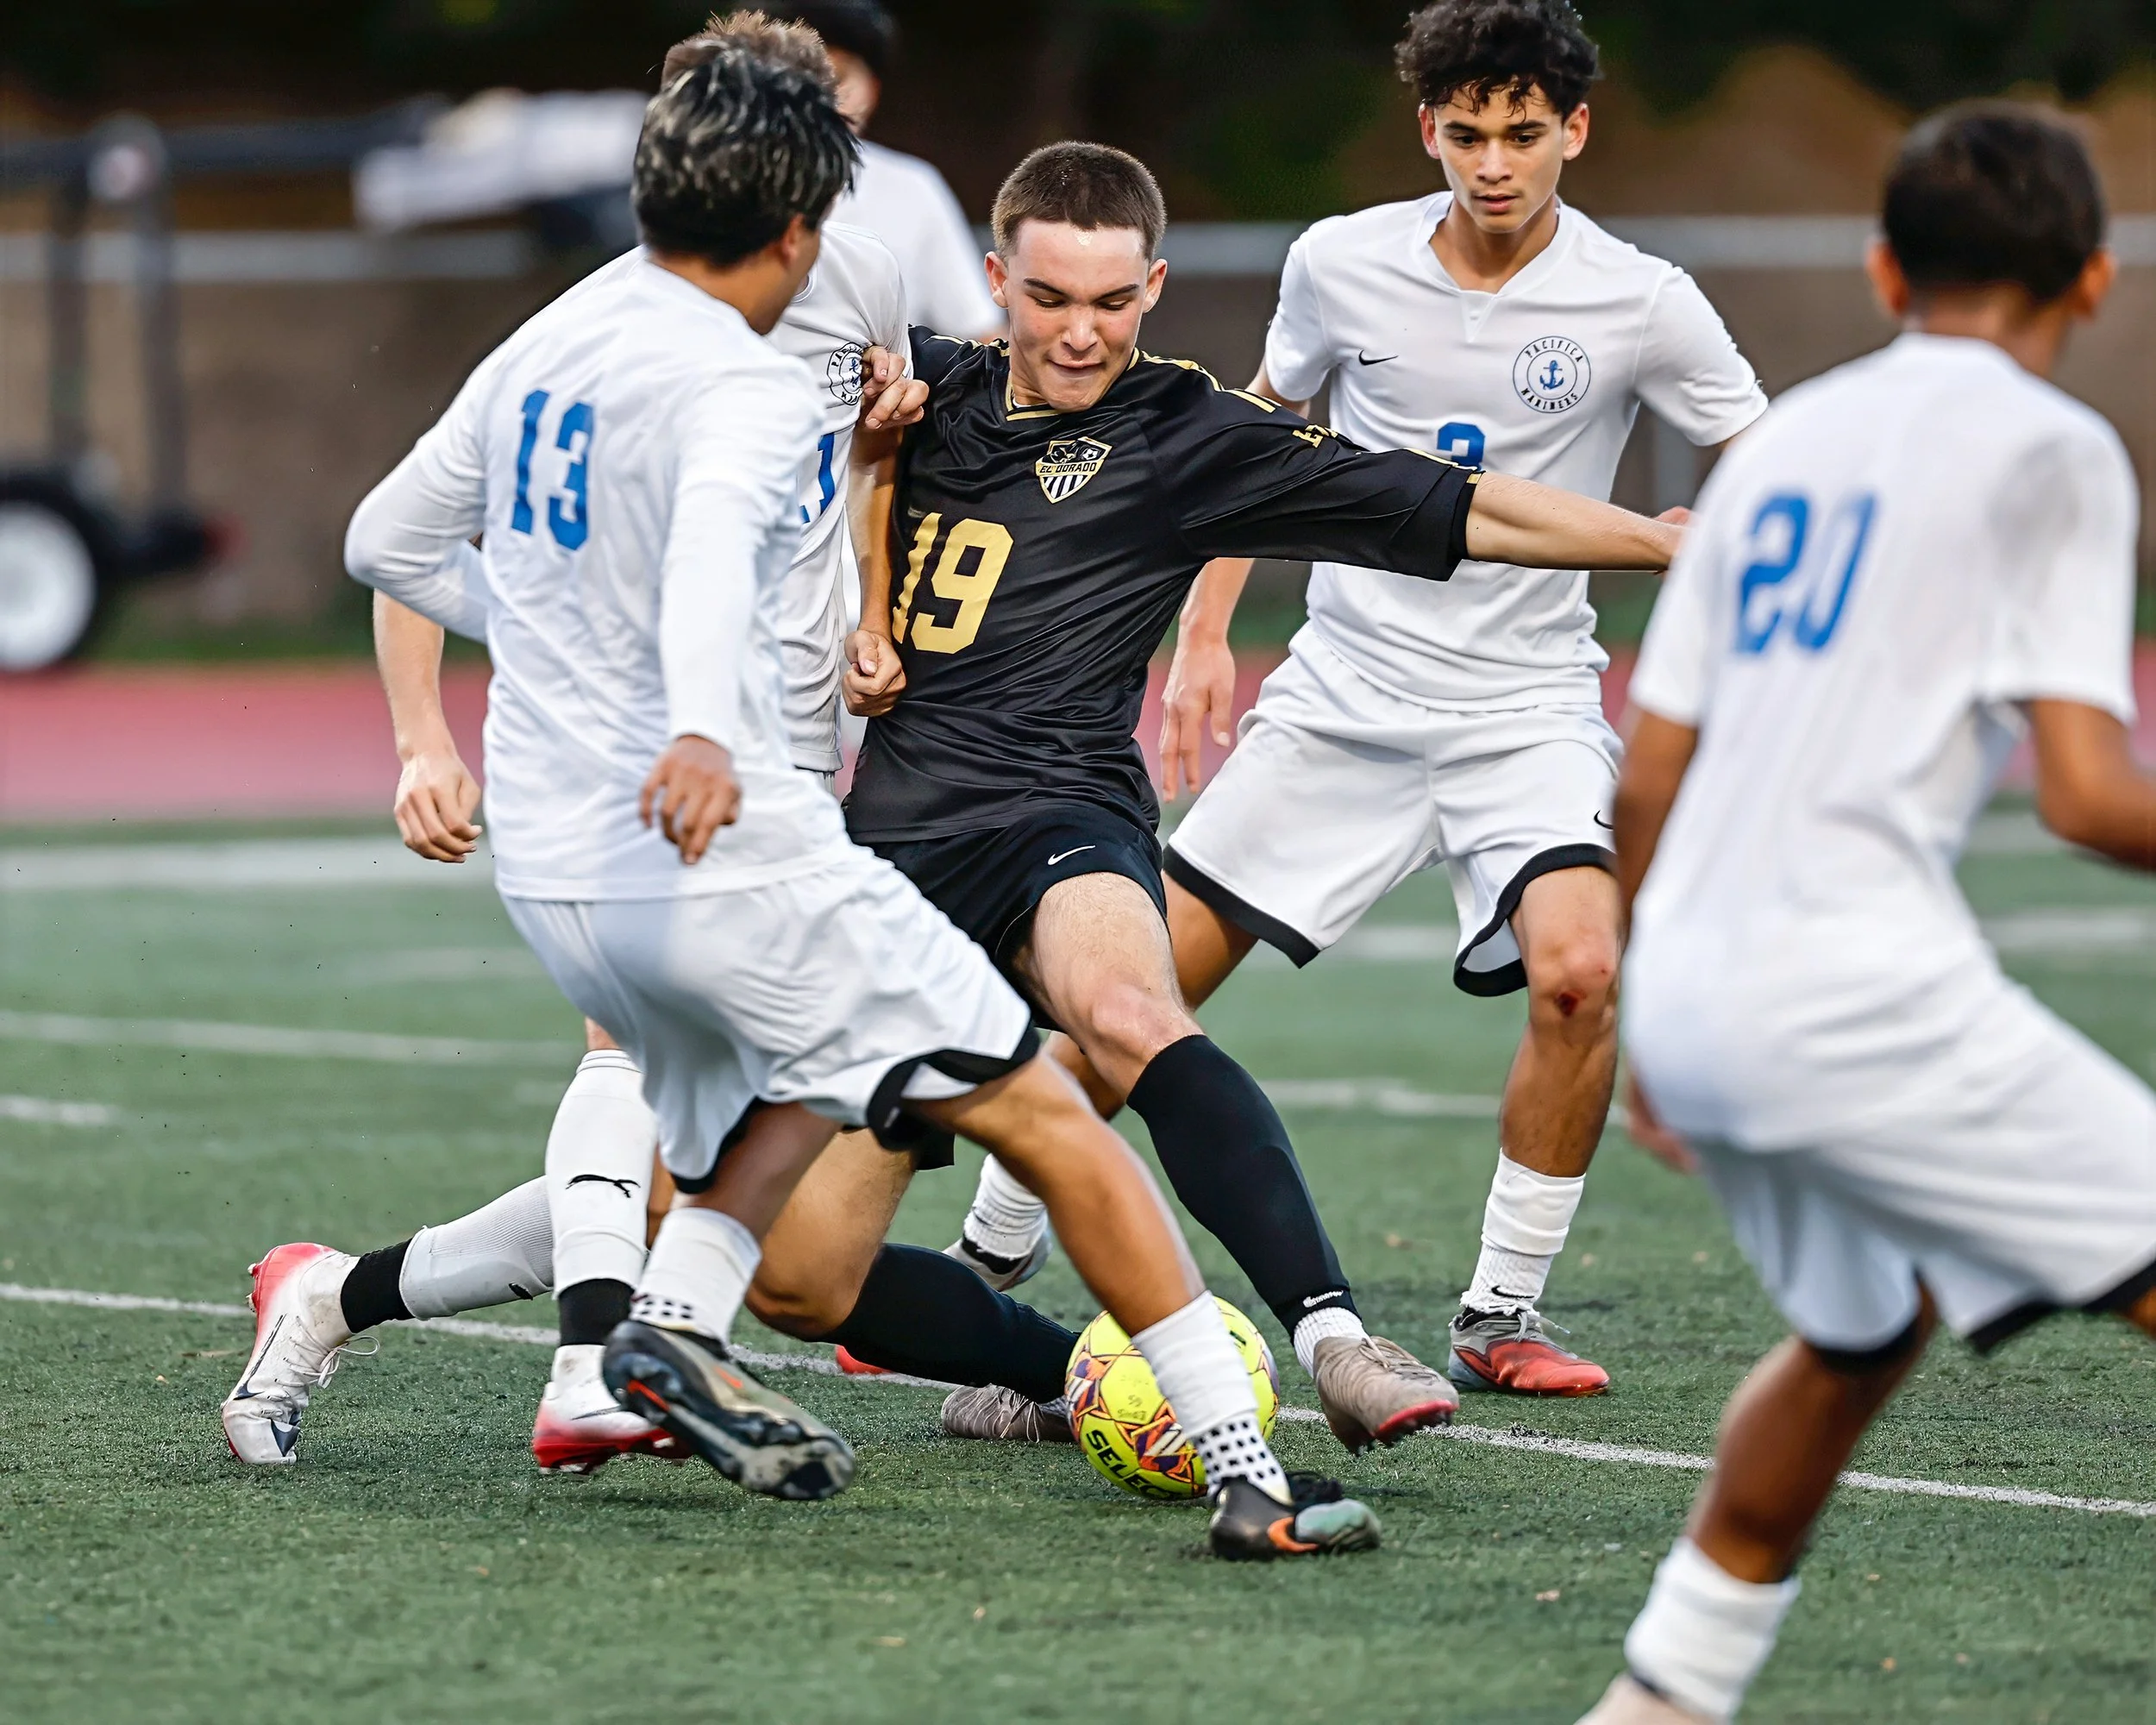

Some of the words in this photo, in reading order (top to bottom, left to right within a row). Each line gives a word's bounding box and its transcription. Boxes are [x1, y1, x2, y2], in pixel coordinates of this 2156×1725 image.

[1524, 339, 1583, 363] PACIFICA
[511, 390, 594, 551] 13
[1055, 462, 1097, 473] DORADO
[892, 511, 1015, 655] 19
[1735, 489, 1874, 653] 20
[1086, 1429, 1173, 1499] SELEC
